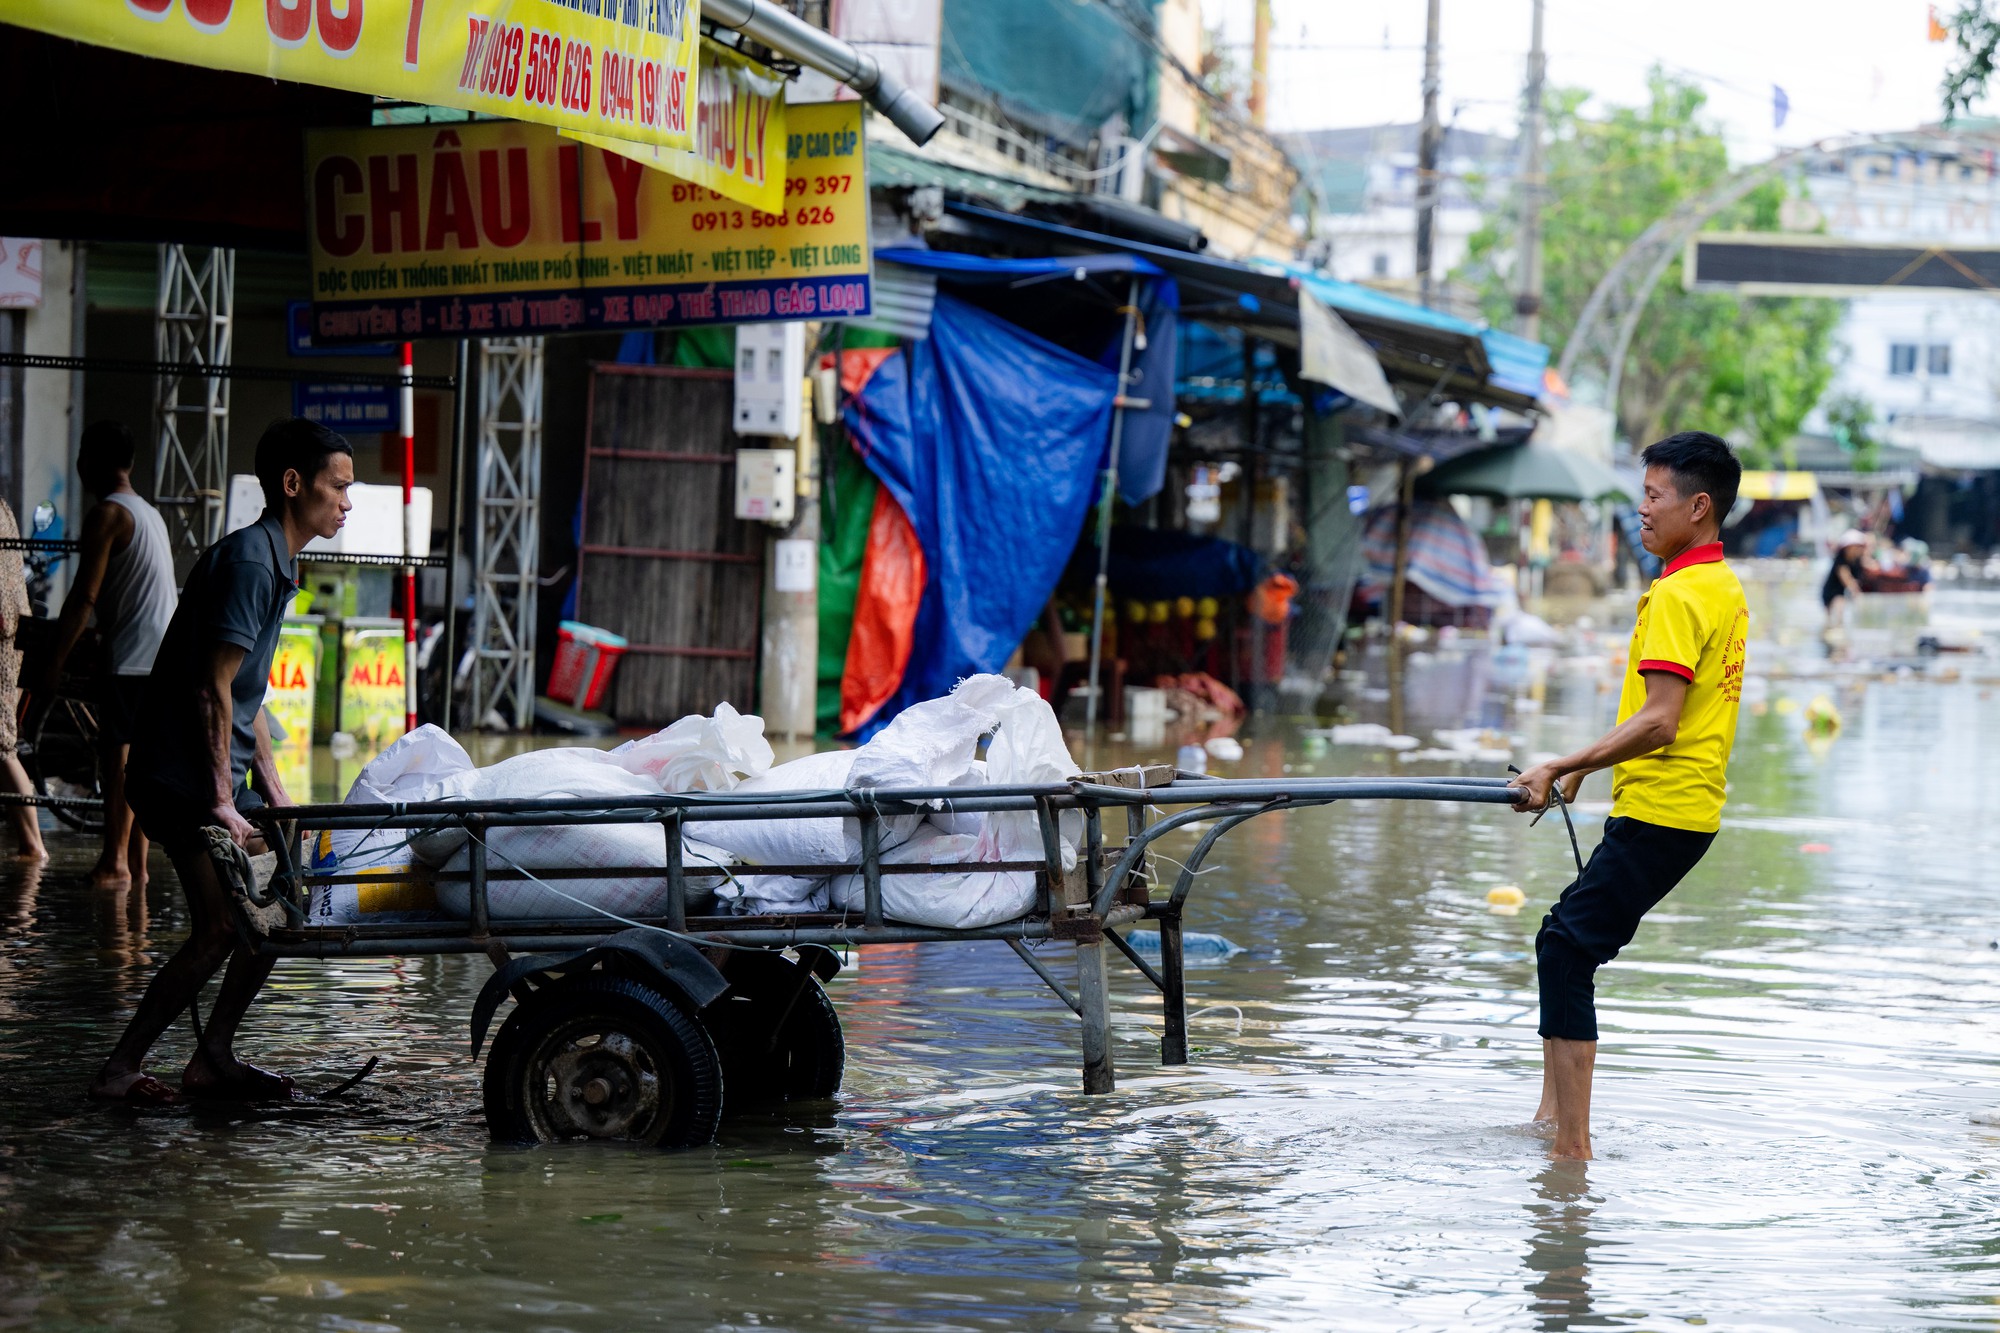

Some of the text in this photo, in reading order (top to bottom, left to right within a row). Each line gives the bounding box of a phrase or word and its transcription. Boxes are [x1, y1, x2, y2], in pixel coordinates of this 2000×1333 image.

[479, 22, 524, 97] 0913
[524, 32, 562, 107] 568
[561, 40, 592, 113] 626
[600, 49, 635, 122] 0944
[637, 61, 662, 127] 199
[663, 65, 687, 132] 397
[786, 132, 803, 165] ẠP
[313, 128, 532, 258] CHÂU
[815, 175, 851, 196] 397
[691, 206, 835, 232] 0913 568 626
[318, 266, 347, 296] ĐỘC
[401, 258, 449, 287] THỐNG
[451, 255, 489, 285] NHẤT
[493, 256, 540, 283] THÀNH
[543, 250, 572, 280] PHỐ
[576, 256, 610, 279] VINH
[622, 250, 652, 281] VIỆT
[656, 248, 695, 279] NHẬT
[711, 246, 741, 276] VIỆT
[745, 244, 777, 275] TIỆP
[789, 243, 820, 273] VIỆT
[824, 243, 862, 266] LONG
[467, 302, 496, 331] XE
[602, 296, 631, 322] XE
[632, 293, 674, 326] ĐẠP
[718, 288, 771, 317] THAO
[773, 281, 817, 316] CÁC
[818, 282, 865, 317] LOẠI
[350, 652, 404, 687] MÍA
